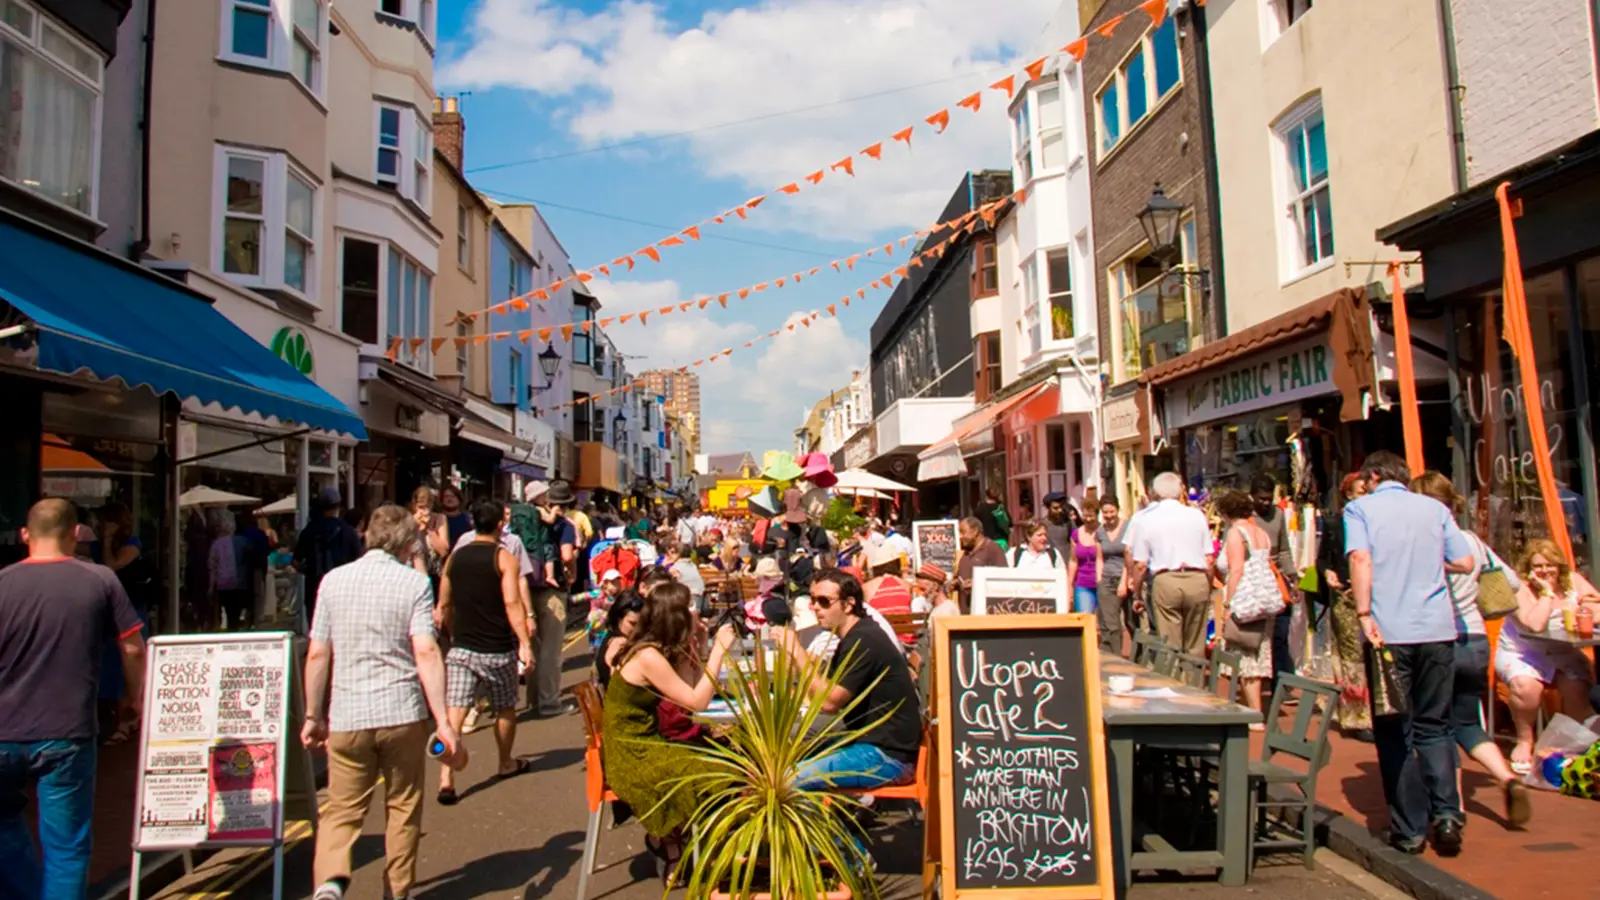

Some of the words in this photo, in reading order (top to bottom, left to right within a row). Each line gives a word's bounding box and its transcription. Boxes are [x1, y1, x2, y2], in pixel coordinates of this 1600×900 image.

[1213, 362, 1272, 409] FABRIC
[1277, 344, 1328, 392] FAIR
[1467, 372, 1556, 424] Utoa
[1475, 426, 1536, 504] Cafe
[160, 662, 199, 676] CHASE
[201, 662, 211, 674] &
[163, 673, 207, 686] STATUS
[956, 641, 1064, 698] Utopia
[157, 687, 210, 699] FRICTION
[161, 702, 201, 714] NOISIA
[960, 688, 1029, 741] Cafe
[1033, 681, 1068, 729] 2
[976, 746, 1079, 769] SMOOTHIES
[1017, 767, 1062, 788] THAN
[962, 785, 1043, 811] ANYWHERE
[1047, 788, 1068, 812] IN
